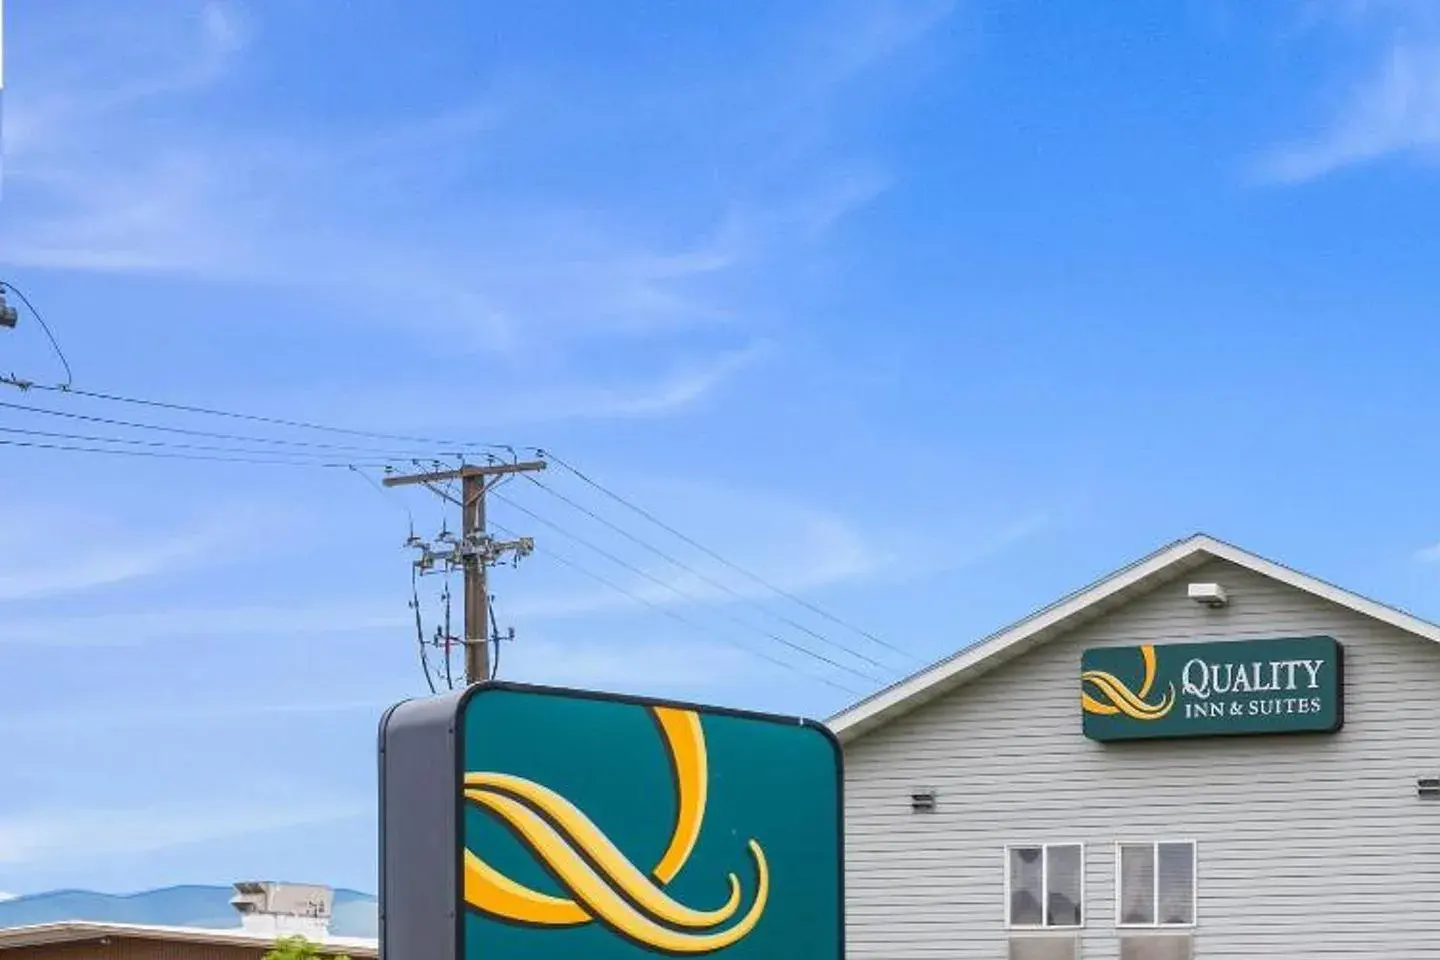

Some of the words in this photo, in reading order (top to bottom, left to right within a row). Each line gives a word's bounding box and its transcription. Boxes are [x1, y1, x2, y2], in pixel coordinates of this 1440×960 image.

[1182, 658, 1324, 698] QUALITY
[1185, 703, 1224, 718] INN
[1230, 704, 1243, 715] &
[1249, 698, 1321, 715] SUITES
